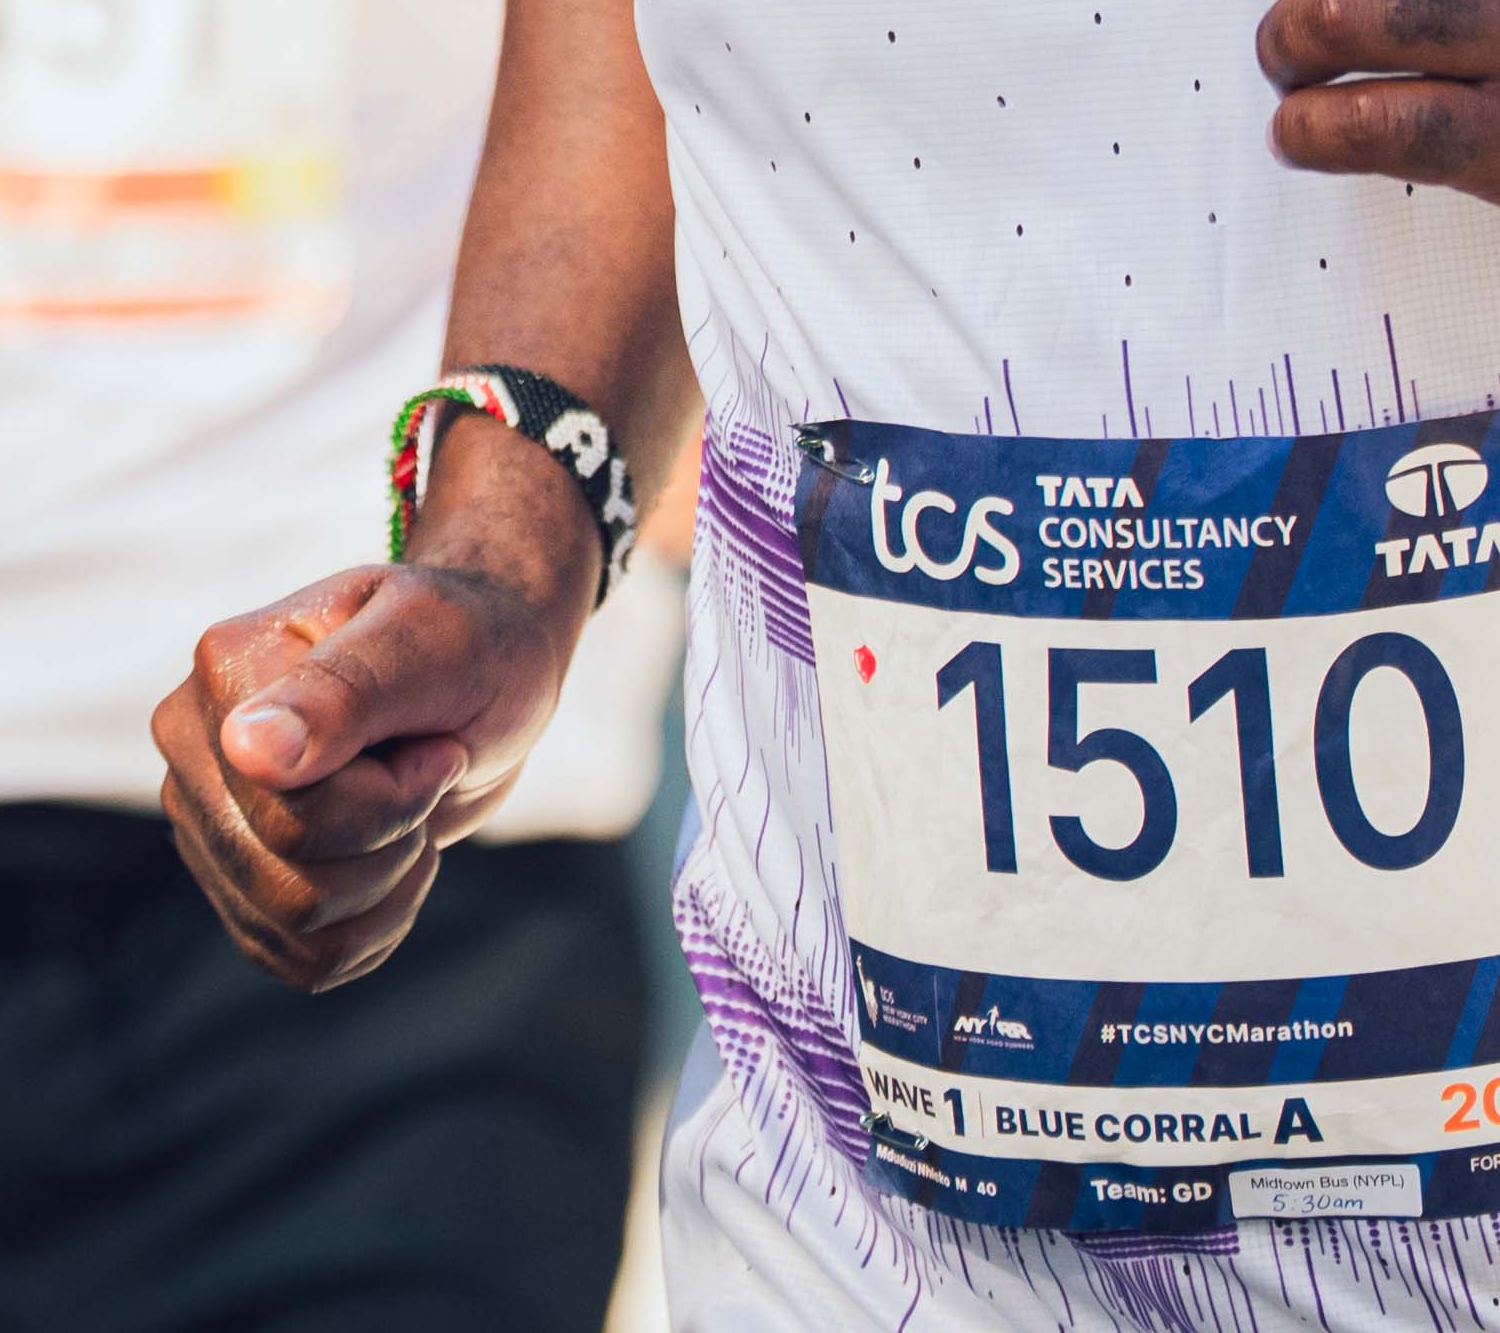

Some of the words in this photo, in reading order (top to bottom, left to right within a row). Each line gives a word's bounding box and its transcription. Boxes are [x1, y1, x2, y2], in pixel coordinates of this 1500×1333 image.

[1036, 475, 1145, 508] TATA
[870, 458, 1020, 587] tcs
[1037, 514, 1298, 550] CONSULTANCY
[1042, 558, 1205, 591] SERVICES
[935, 631, 1465, 881] 1510
[1100, 1020, 1354, 1045] #TCSNYCMarathon
[867, 1067, 936, 1118] WAVE
[943, 1088, 965, 1137] 1
[996, 1105, 1085, 1141] BLUE
[1094, 1112, 1262, 1143] CORRAL
[1273, 1097, 1324, 1145] A
[955, 1176, 968, 1193] M
[976, 1181, 997, 1197] 40
[1090, 1179, 1167, 1204] Team:
[1172, 1181, 1213, 1204] GD
[1250, 1176, 1315, 1192] Midtown
[1320, 1175, 1350, 1190] Bus
[1353, 1174, 1405, 1190] (NYPL)
[1273, 1193, 1364, 1214] 5:30am
